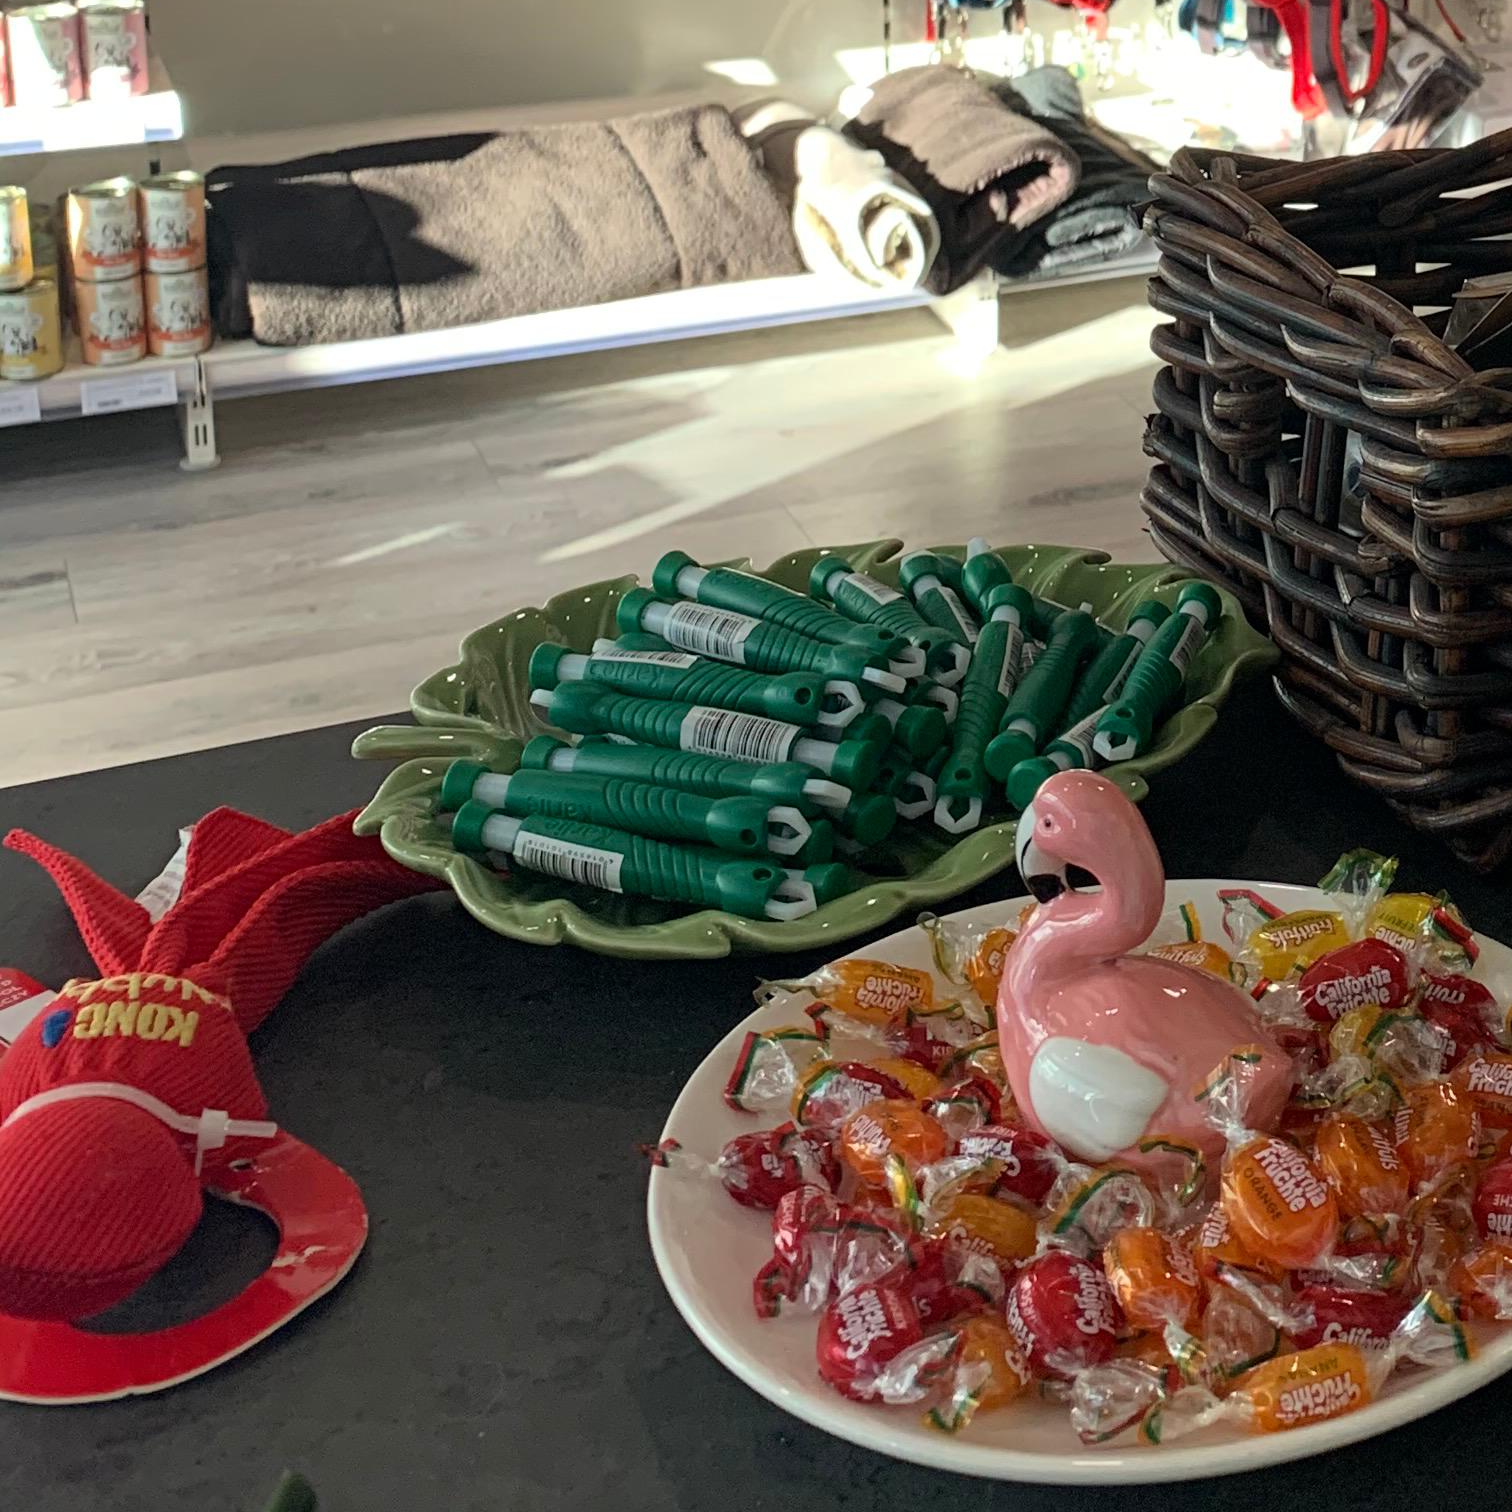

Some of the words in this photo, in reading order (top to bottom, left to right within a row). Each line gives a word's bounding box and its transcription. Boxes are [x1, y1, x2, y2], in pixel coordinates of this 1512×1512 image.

[1314, 965, 1392, 1006] California
[73, 1000, 199, 1048] KONG
[1267, 1137, 1330, 1209] California
